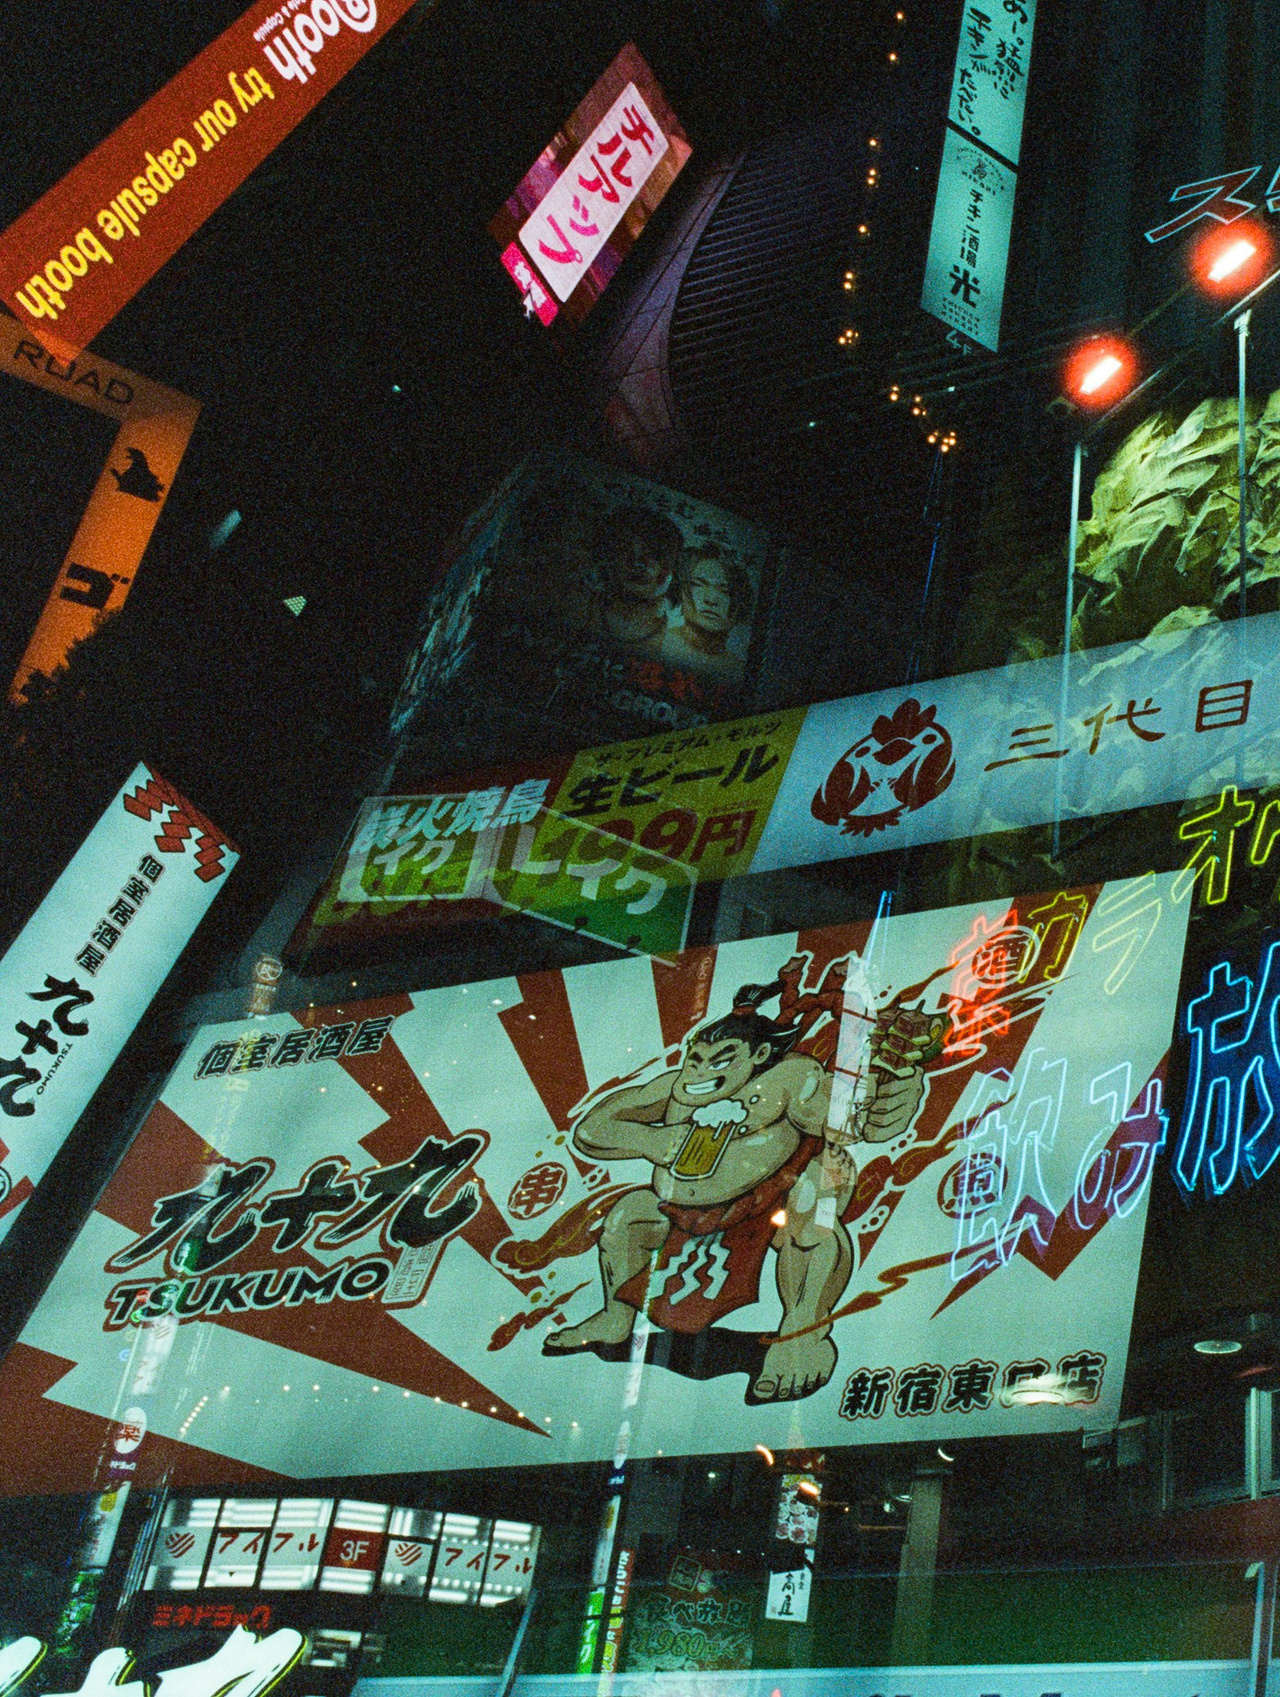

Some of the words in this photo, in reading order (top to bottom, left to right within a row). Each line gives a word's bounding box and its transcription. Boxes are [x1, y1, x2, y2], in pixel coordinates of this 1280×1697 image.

[192, 97, 238, 153] our
[236, 67, 275, 115] try
[97, 136, 199, 243] capsule
[538, 104, 656, 264] チルアップ
[15, 226, 115, 321] booth
[948, 264, 982, 309] 光
[564, 743, 781, 819] 生ビール
[511, 824, 668, 916] レイク
[75, 851, 165, 979] 個室居酒屋
[0, 972, 96, 1118] 九十九
[36, 1042, 74, 1096] TSUKUMO
[195, 1015, 394, 1081] 個室居酒屋
[108, 1132, 488, 1275] 九十九
[512, 1163, 565, 1217] 串
[107, 1258, 393, 1326] TSUKUMO
[838, 1352, 1108, 1421] 新宿東口店
[217, 1531, 320, 1556] アイフル
[340, 1538, 368, 1563] 3F
[443, 1547, 532, 1576] アイフル
